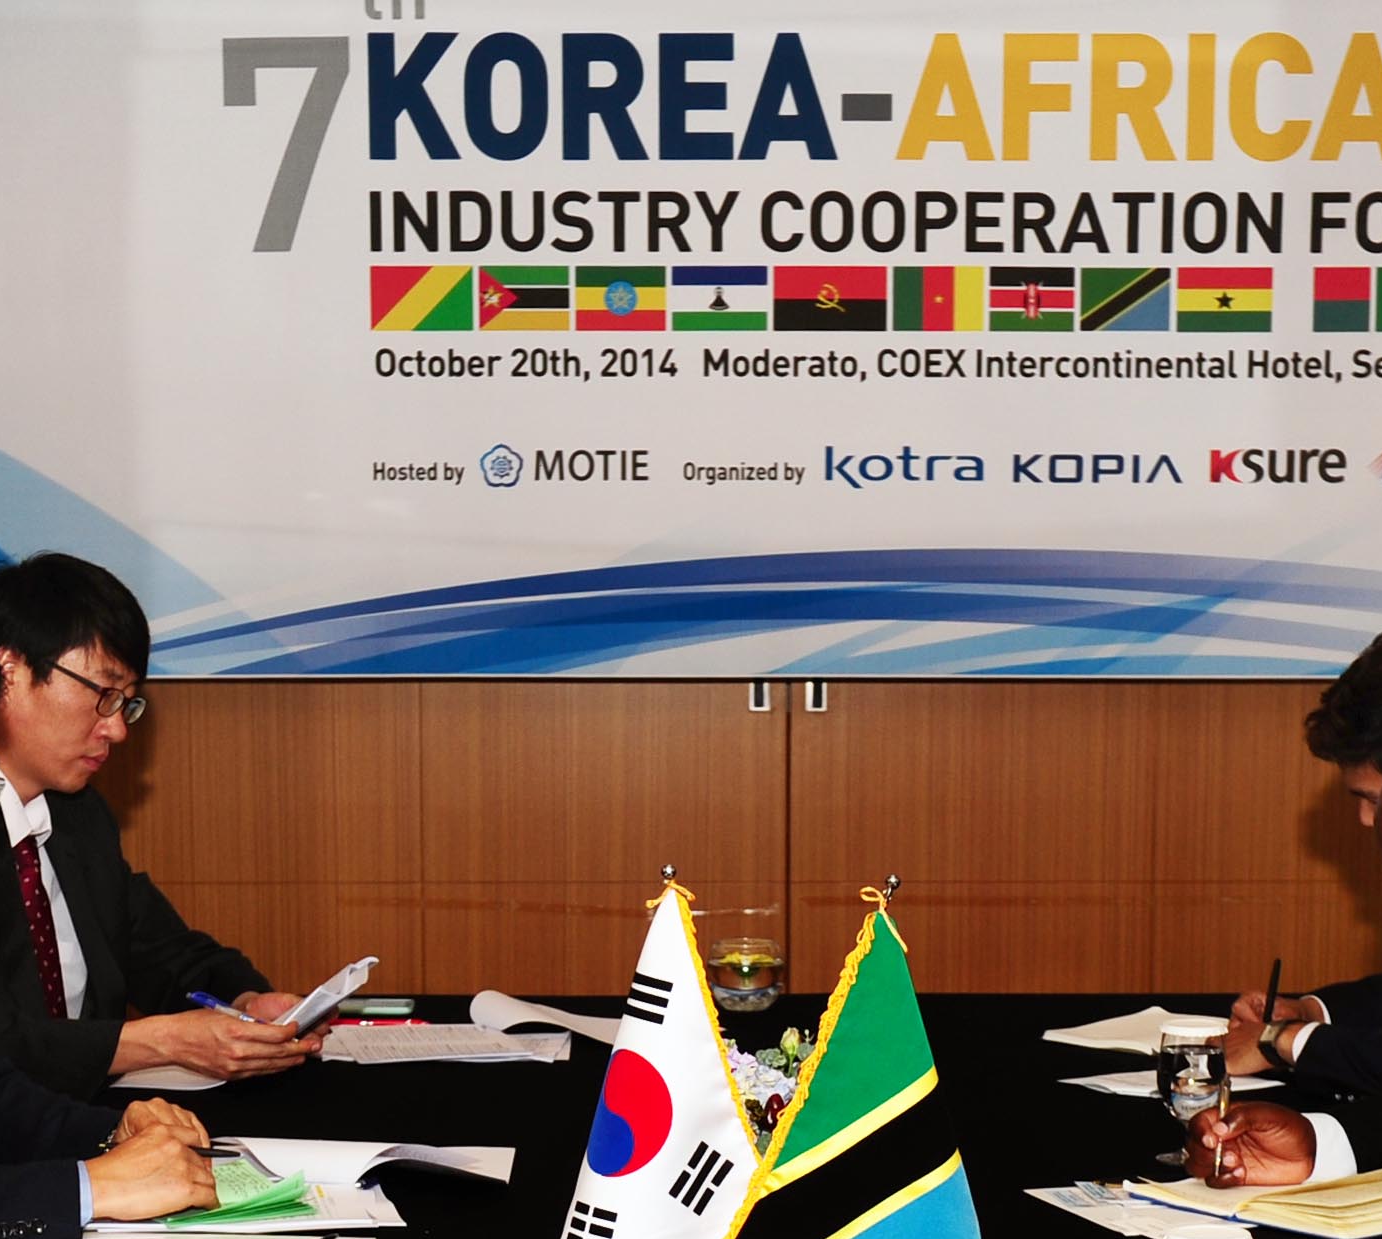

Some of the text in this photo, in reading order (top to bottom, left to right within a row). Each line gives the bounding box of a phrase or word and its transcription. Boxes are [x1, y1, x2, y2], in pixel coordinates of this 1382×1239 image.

[222, 36, 350, 253] 7
[369, 190, 741, 254] INDUSTRY
[760, 190, 1285, 255] COOPERATION
[374, 347, 679, 383] October 20th, 2014
[703, 347, 867, 383] Moderato,
[877, 348, 967, 379] COEX
[975, 348, 1238, 379] Intercontinental
[1247, 348, 1343, 384] Hotel,
[372, 461, 466, 486] Hosted by
[533, 449, 650, 482] MOTIE
[682, 461, 806, 486] Organized by
[1012, 453, 1184, 484] KOPIA
